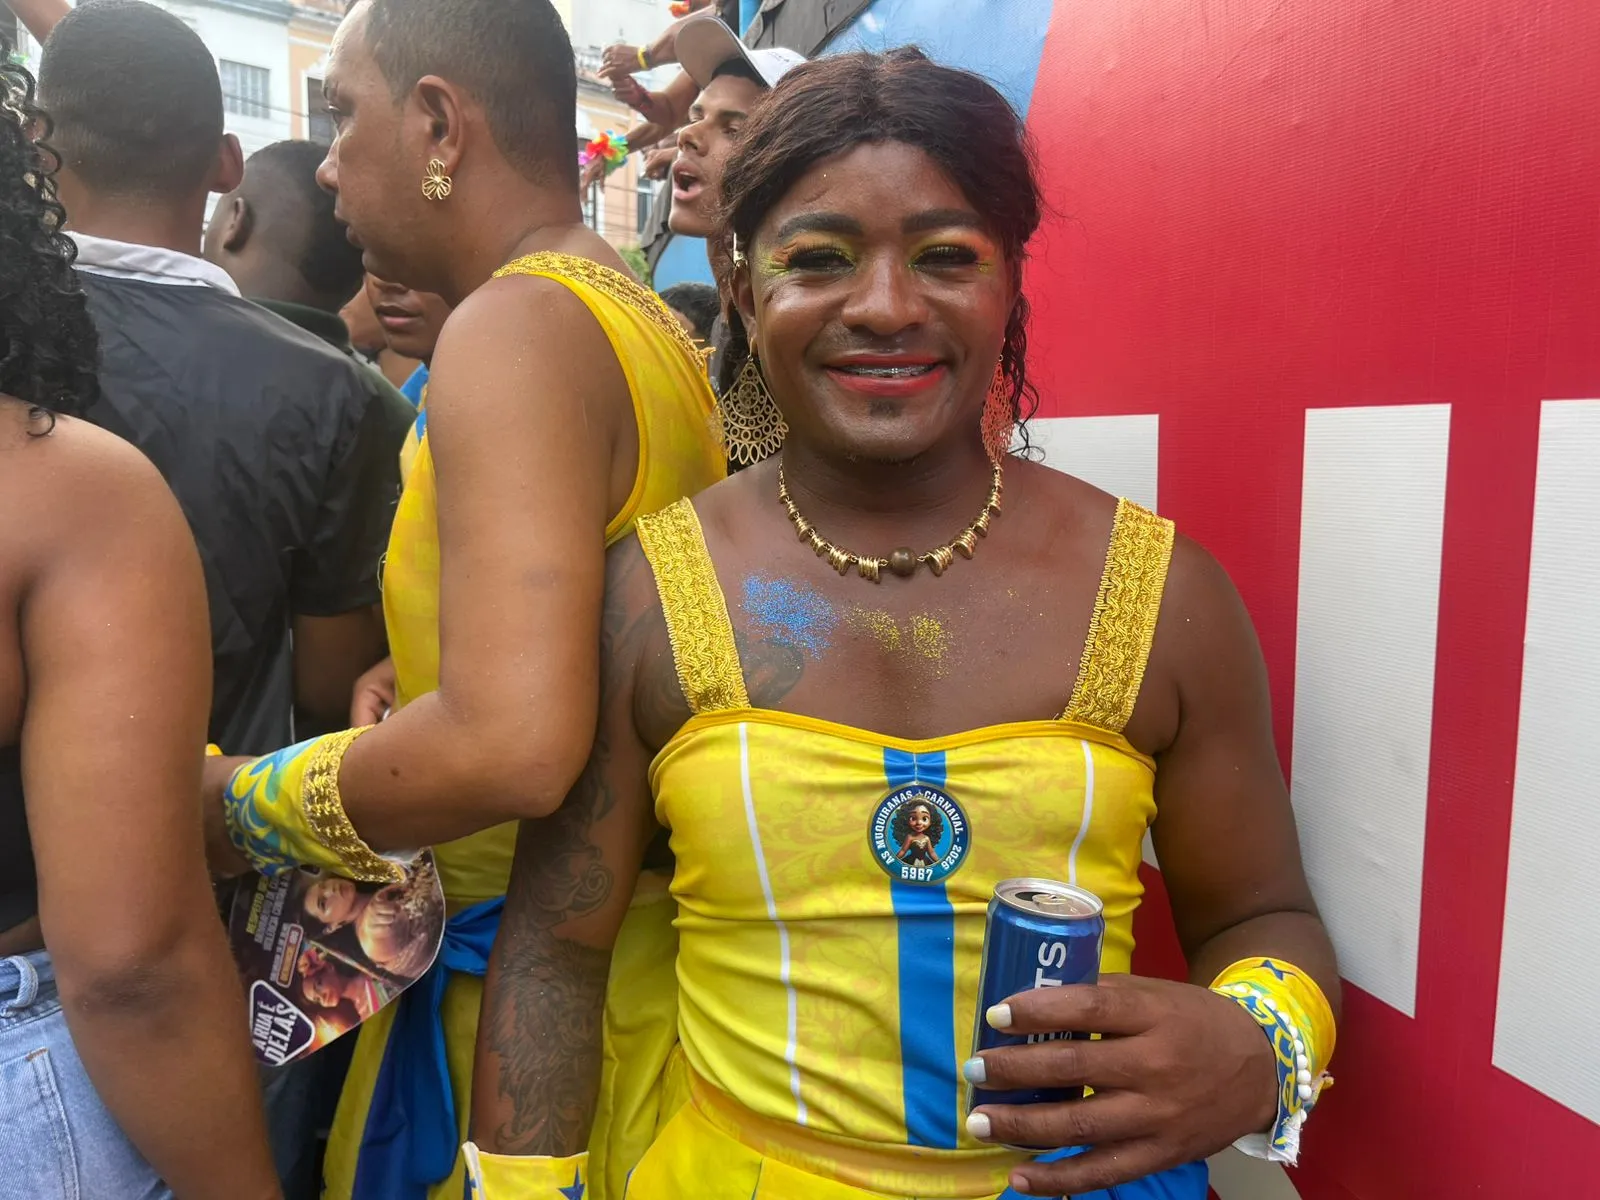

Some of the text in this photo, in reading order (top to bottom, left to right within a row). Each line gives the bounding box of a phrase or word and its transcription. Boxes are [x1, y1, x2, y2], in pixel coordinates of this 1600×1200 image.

[874, 790, 913, 866] AS MUQUIRANAS
[924, 790, 964, 835] CARNAVAL
[901, 866, 933, 882] 5967
[941, 845, 962, 871] 2026
[252, 1000, 278, 1052] A RUA É
[264, 1001, 298, 1065] DELAS
